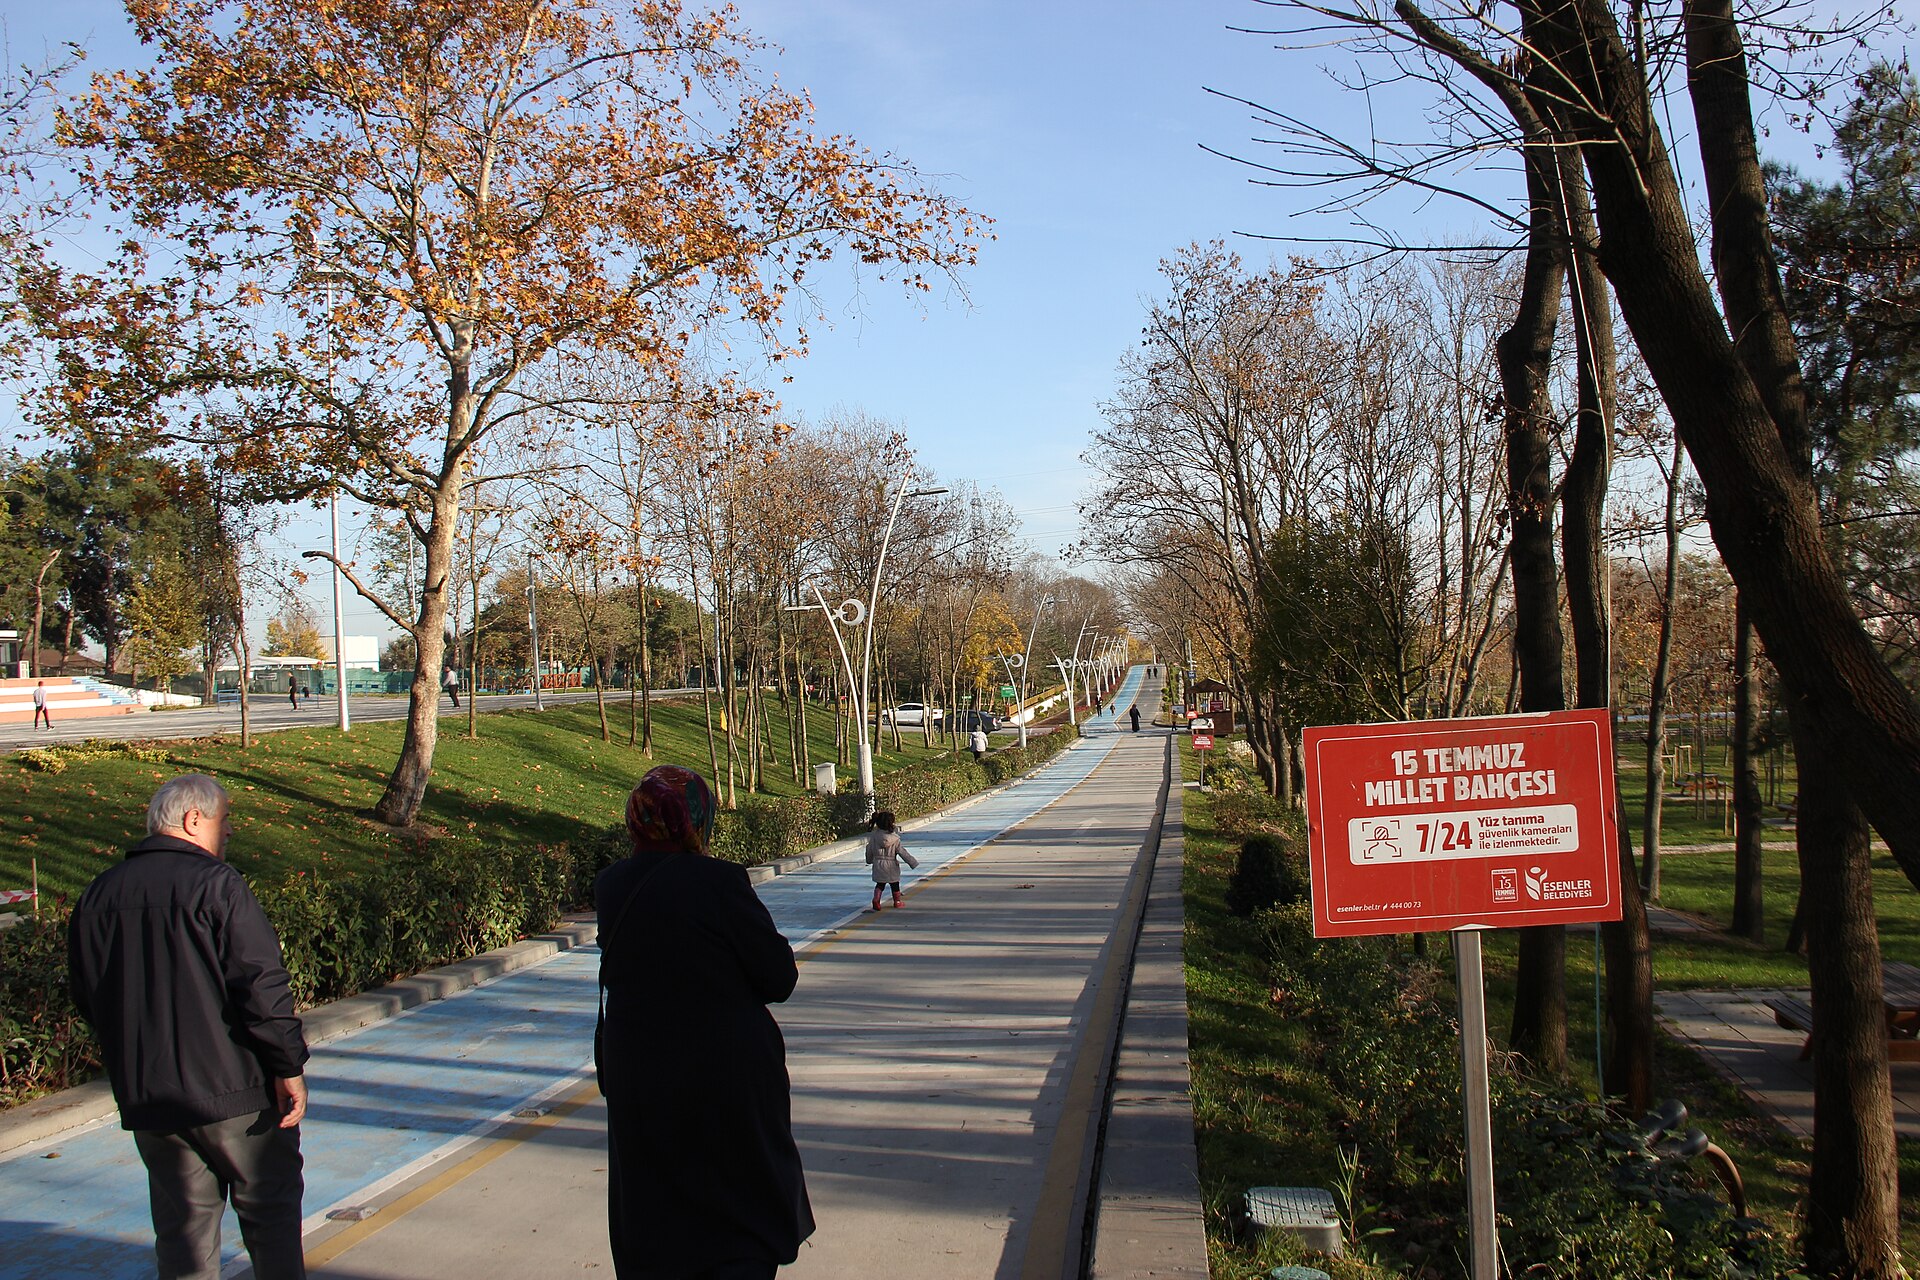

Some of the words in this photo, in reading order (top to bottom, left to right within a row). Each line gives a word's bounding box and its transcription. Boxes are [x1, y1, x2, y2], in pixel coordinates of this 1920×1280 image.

[1392, 750, 1418, 776] 15
[1423, 742, 1526, 774] TEMMUZ
[1364, 777, 1447, 806] MİLLET
[1454, 770, 1556, 800] BAHÇESİ
[1477, 816, 1500, 828] Yüz
[1502, 814, 1544, 826] tanıma
[1416, 819, 1472, 854] 7/24
[1478, 827, 1520, 840] güvenlik
[1522, 824, 1572, 836] kameraları
[1479, 840, 1490, 850] ile
[1493, 836, 1560, 850] izlenmektedir.
[1499, 878, 1512, 890] 15
[1543, 880, 1591, 892] ESENLER
[1544, 890, 1592, 900] BELEDİYESİ
[1336, 904, 1380, 912] esenler.bel.tr
